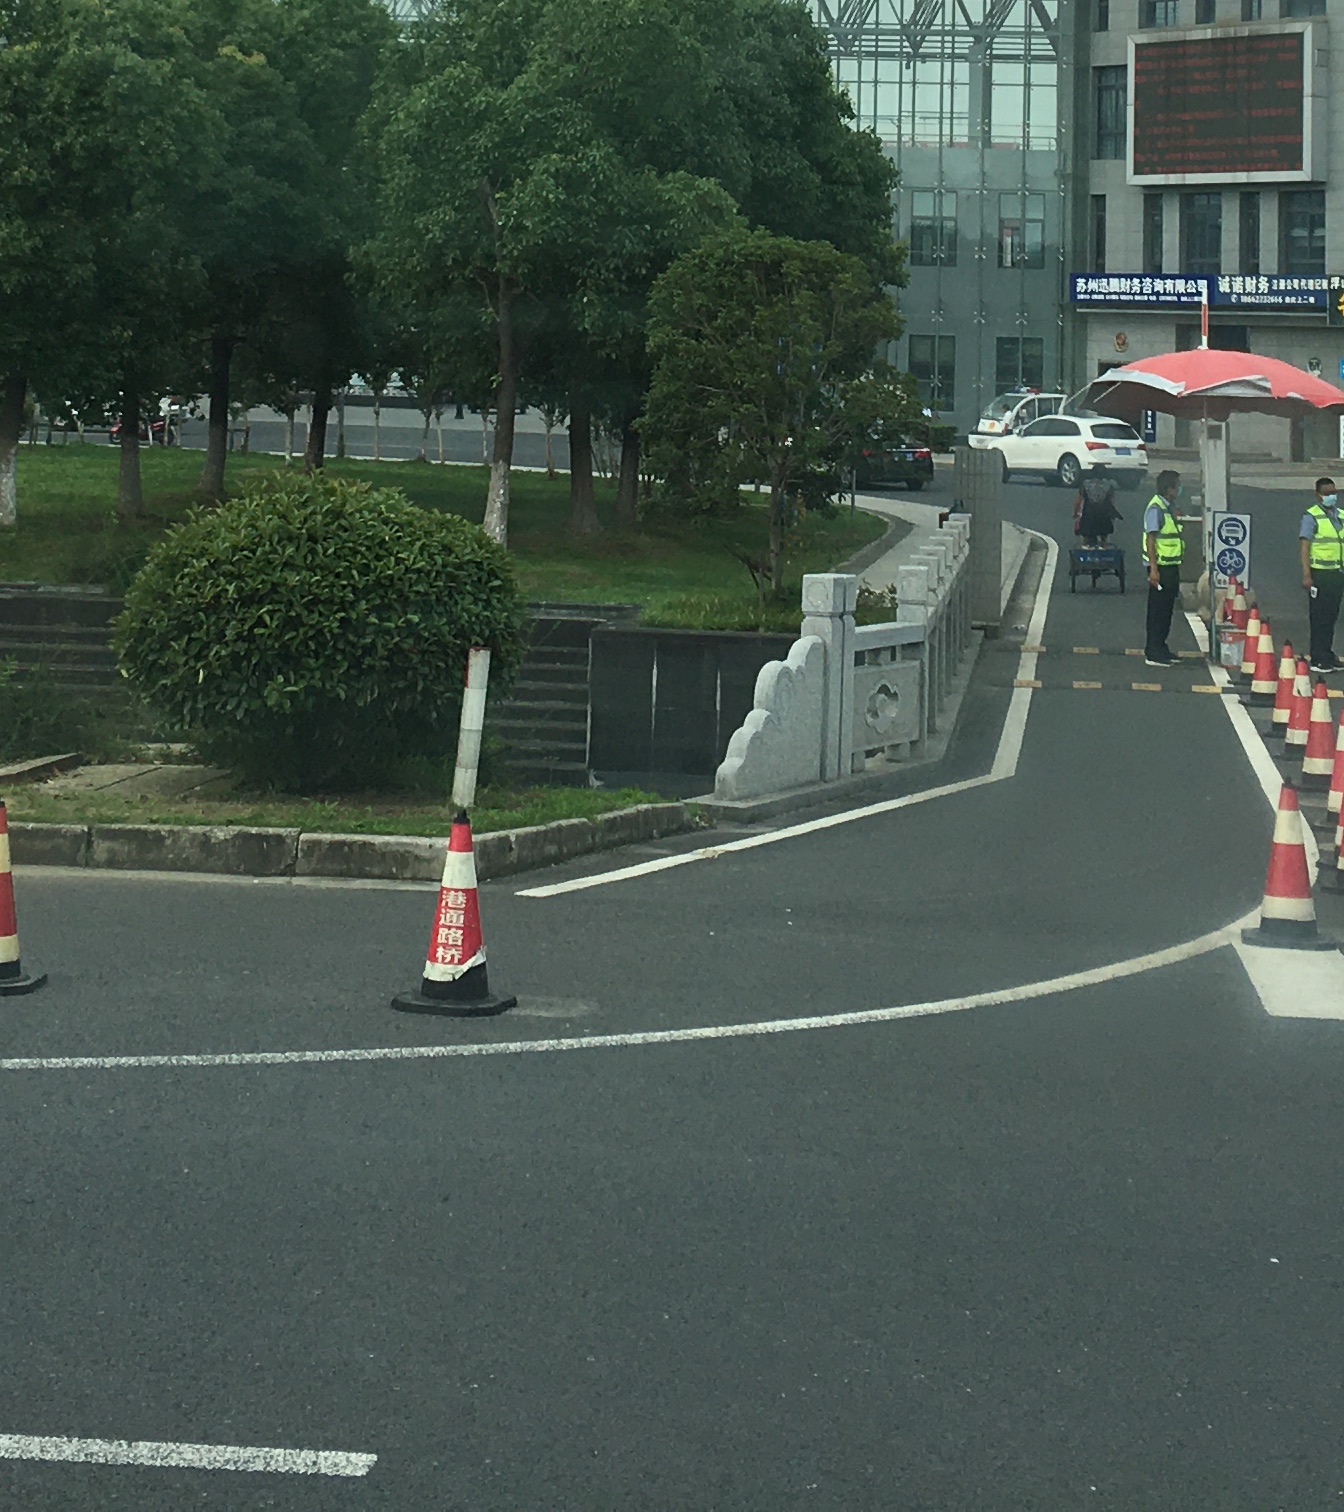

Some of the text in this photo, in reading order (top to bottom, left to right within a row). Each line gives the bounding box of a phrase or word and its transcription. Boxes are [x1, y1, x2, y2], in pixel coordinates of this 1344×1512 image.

[1218, 275, 1269, 294] 诚诺财务
[436, 890, 467, 964] 港通路桥
